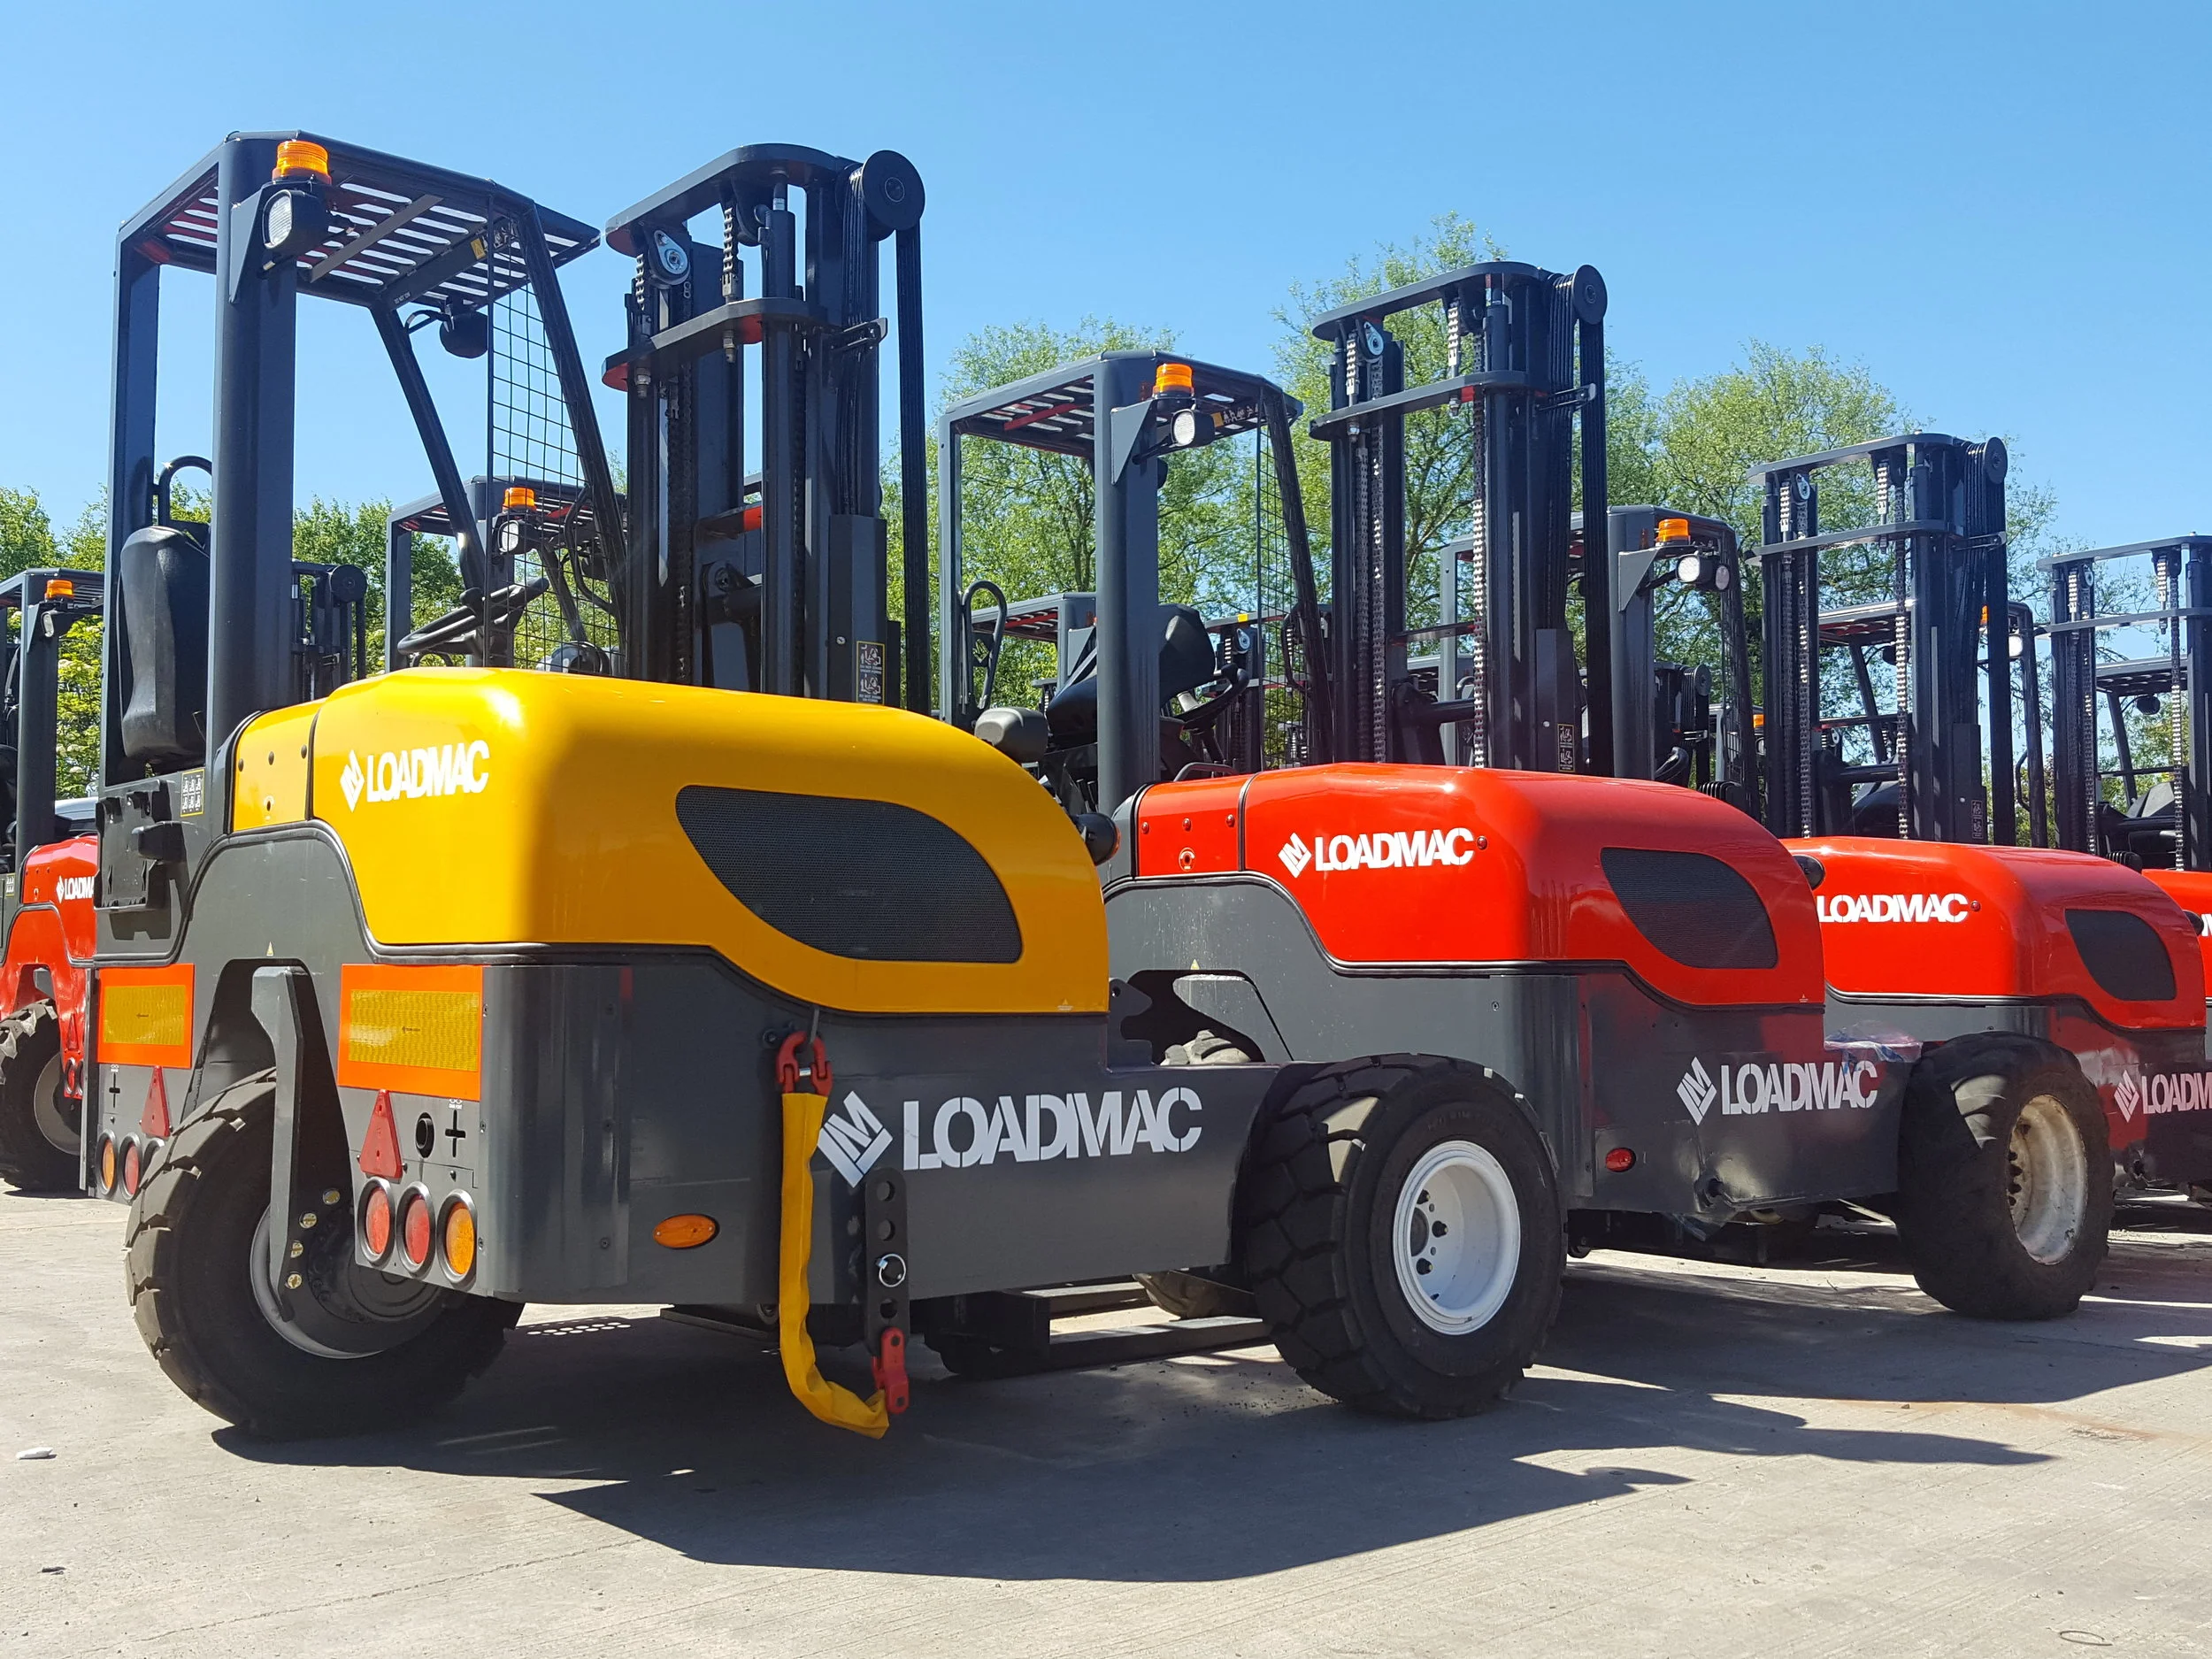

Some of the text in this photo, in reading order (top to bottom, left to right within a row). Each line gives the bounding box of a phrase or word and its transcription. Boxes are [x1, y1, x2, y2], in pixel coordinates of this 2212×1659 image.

[367, 740, 490, 803] LOADMAC
[1315, 827, 1474, 872] LOADMAC
[1816, 894, 1969, 923] LOADMAC
[1721, 1061, 1878, 1115] LOADMAC
[903, 1087, 1202, 1171] LOADMAC
